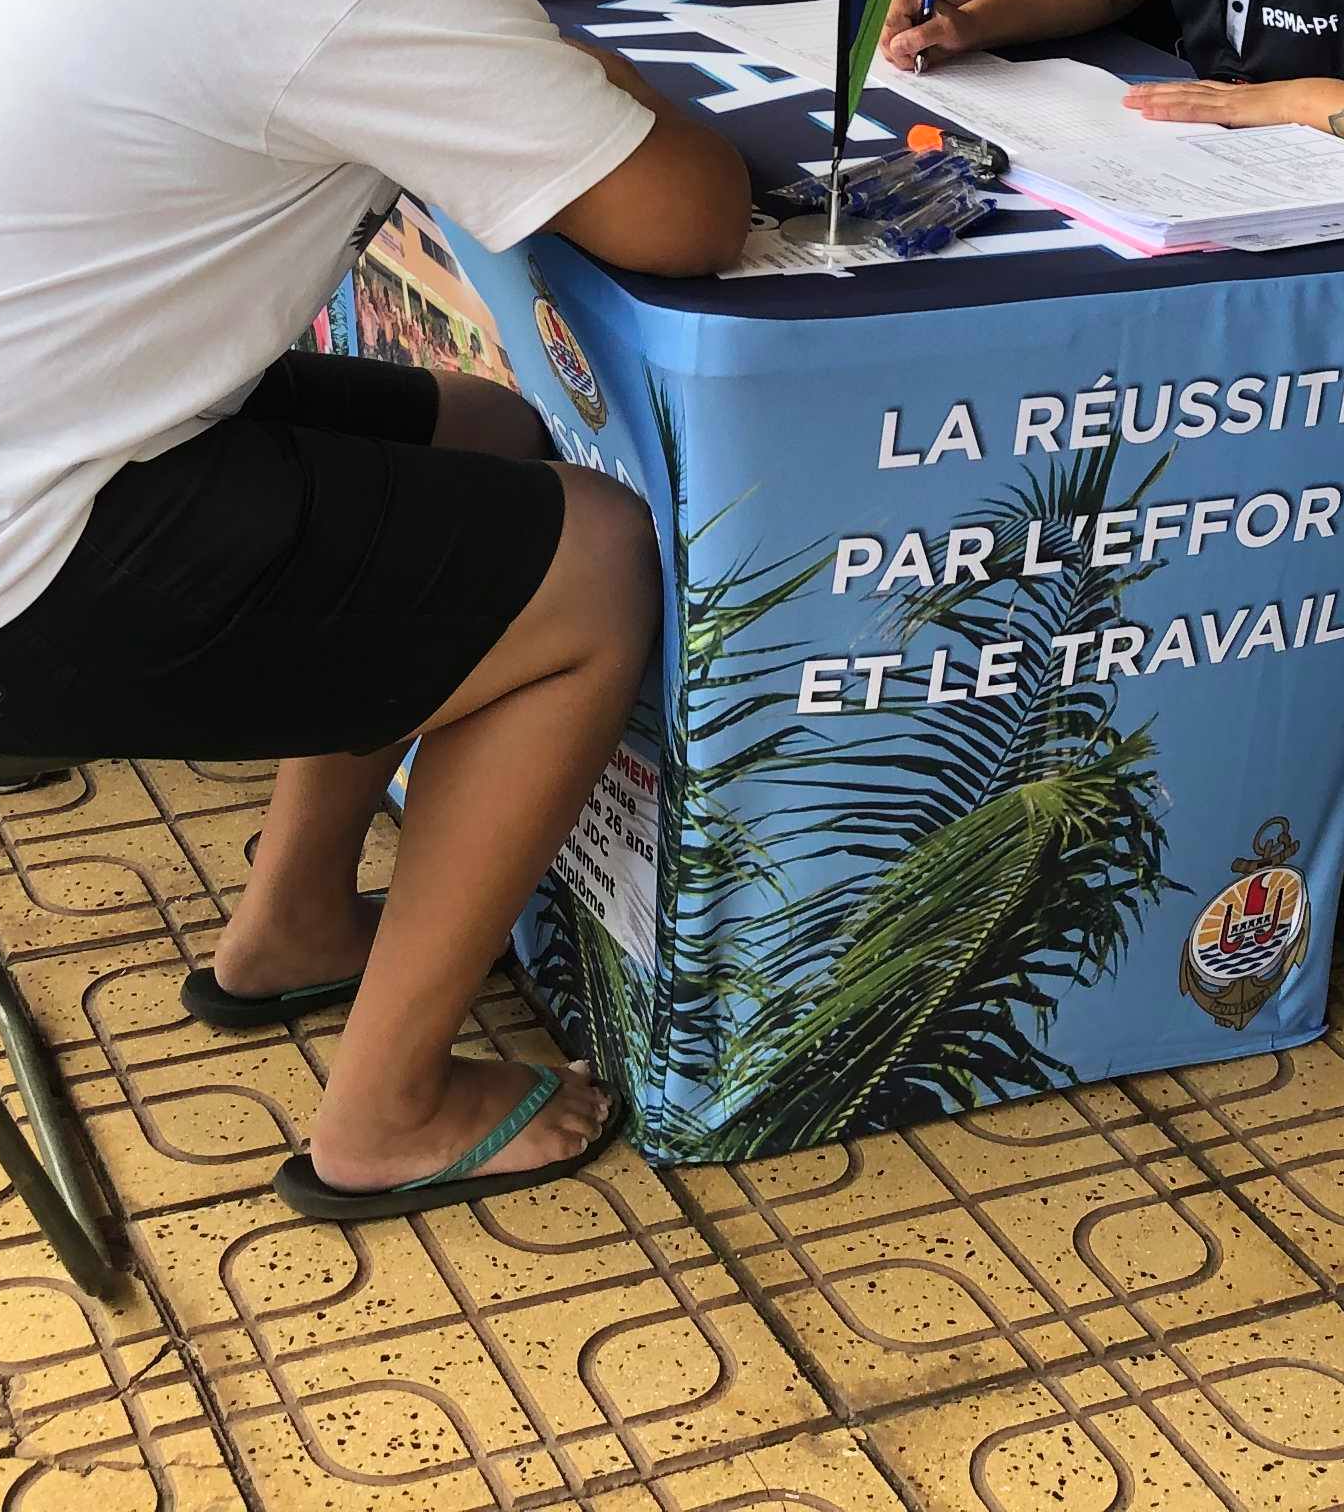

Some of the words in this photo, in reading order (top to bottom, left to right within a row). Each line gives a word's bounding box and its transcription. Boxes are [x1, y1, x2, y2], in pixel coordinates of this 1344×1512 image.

[876, 403, 984, 470] LA
[831, 526, 994, 595] PAR
[796, 654, 902, 714] ET
[926, 641, 1024, 704] LE
[582, 818, 610, 858] JDC
[604, 806, 622, 836] 26
[625, 830, 654, 863] ans
[555, 852, 606, 920] diplôme
